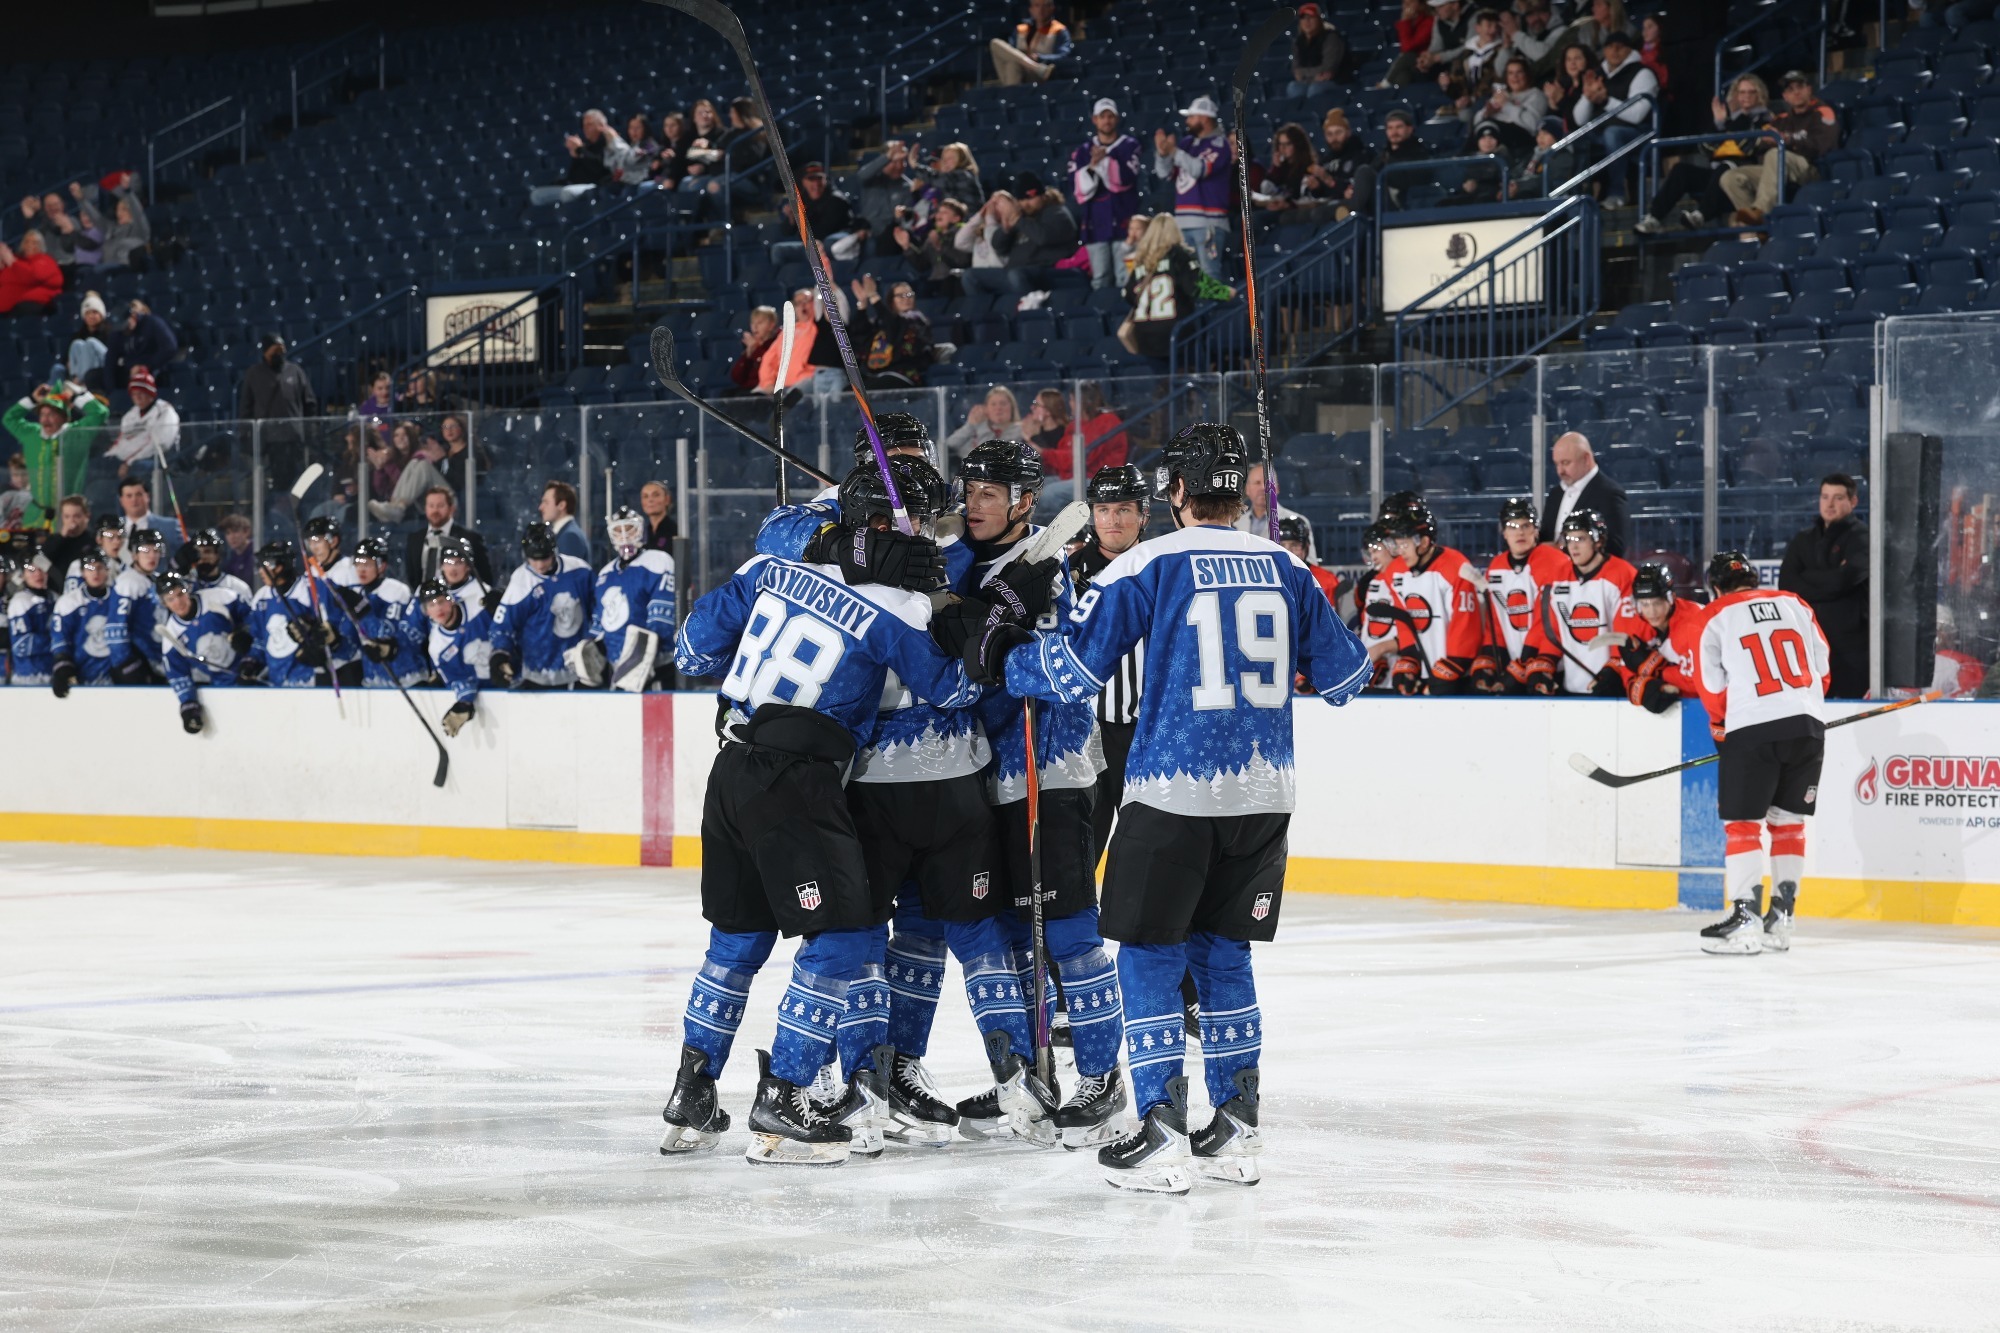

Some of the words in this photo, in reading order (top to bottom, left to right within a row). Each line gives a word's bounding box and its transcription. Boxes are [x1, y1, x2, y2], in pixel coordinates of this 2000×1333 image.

[1134, 273, 1177, 322] 12
[1257, 402, 1267, 460] BAUER
[1224, 473, 1239, 489] 19
[1195, 557, 1276, 586] SVITOV
[756, 563, 875, 634] UTKOVSKIY
[1068, 588, 1102, 624] 9
[1458, 591, 1476, 613] 16
[1751, 603, 1779, 622] KIM
[720, 591, 846, 710] 88
[1186, 590, 1290, 712] 19
[1740, 628, 1813, 697] 10
[1885, 793, 1919, 806] FIRE
[1925, 794, 2000, 808] PROTECT
[1919, 816, 1954, 827] POWERED
[800, 889, 819, 900] USHL
[1034, 893, 1044, 947] BAUER
